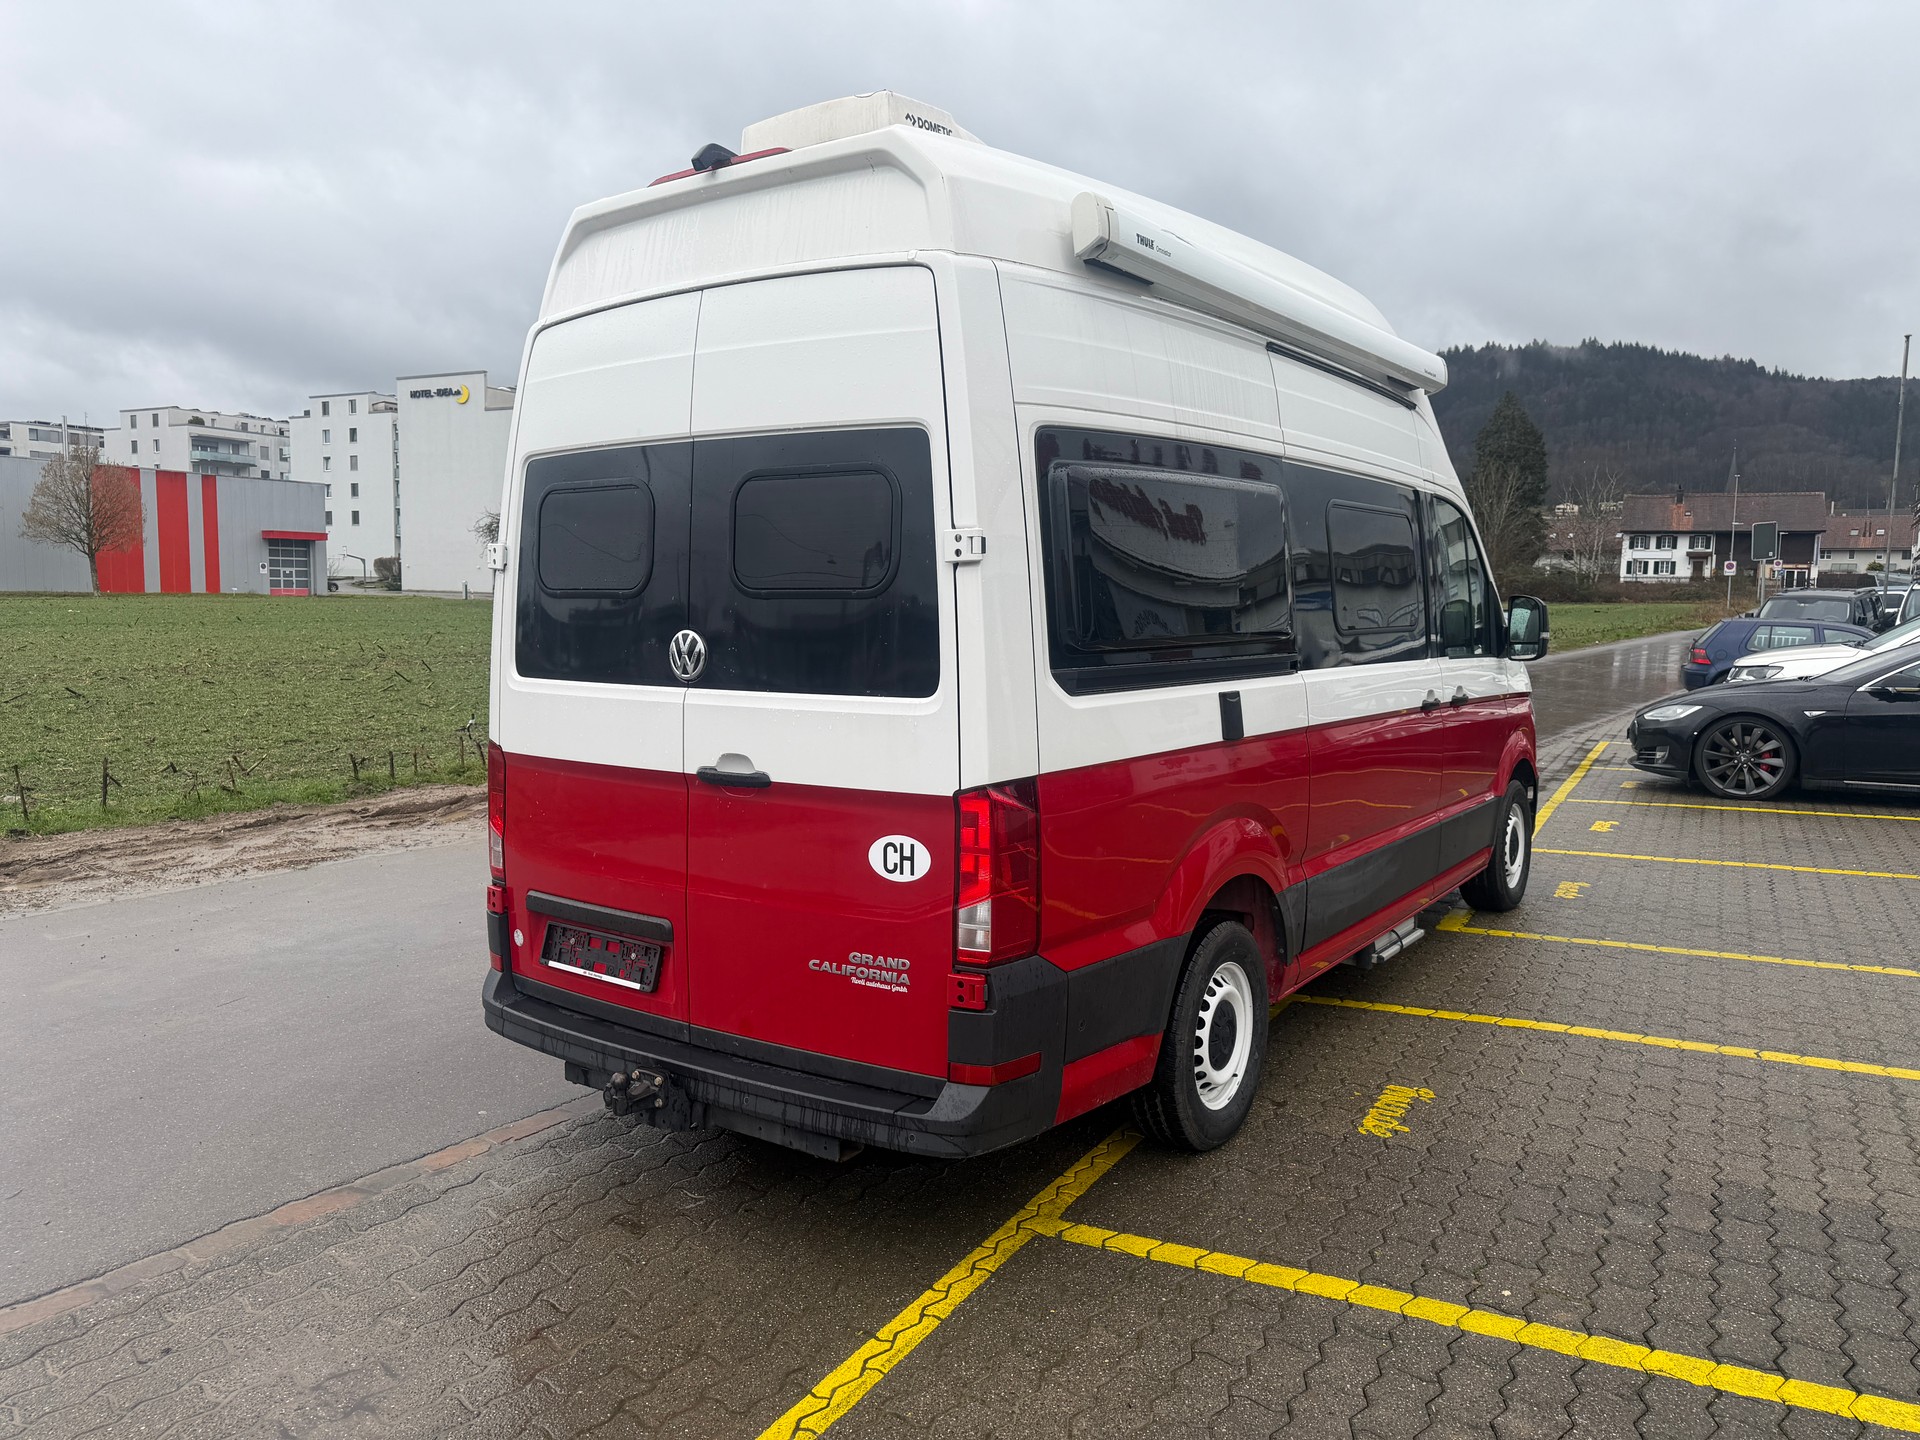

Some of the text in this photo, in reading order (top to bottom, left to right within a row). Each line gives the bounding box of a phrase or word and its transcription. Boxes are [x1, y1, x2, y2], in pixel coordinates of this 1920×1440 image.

[1136, 232, 1155, 250] THULE
[883, 842, 915, 876] CH
[808, 959, 911, 985] CALIFORNIA
[848, 952, 911, 971] GRAND
